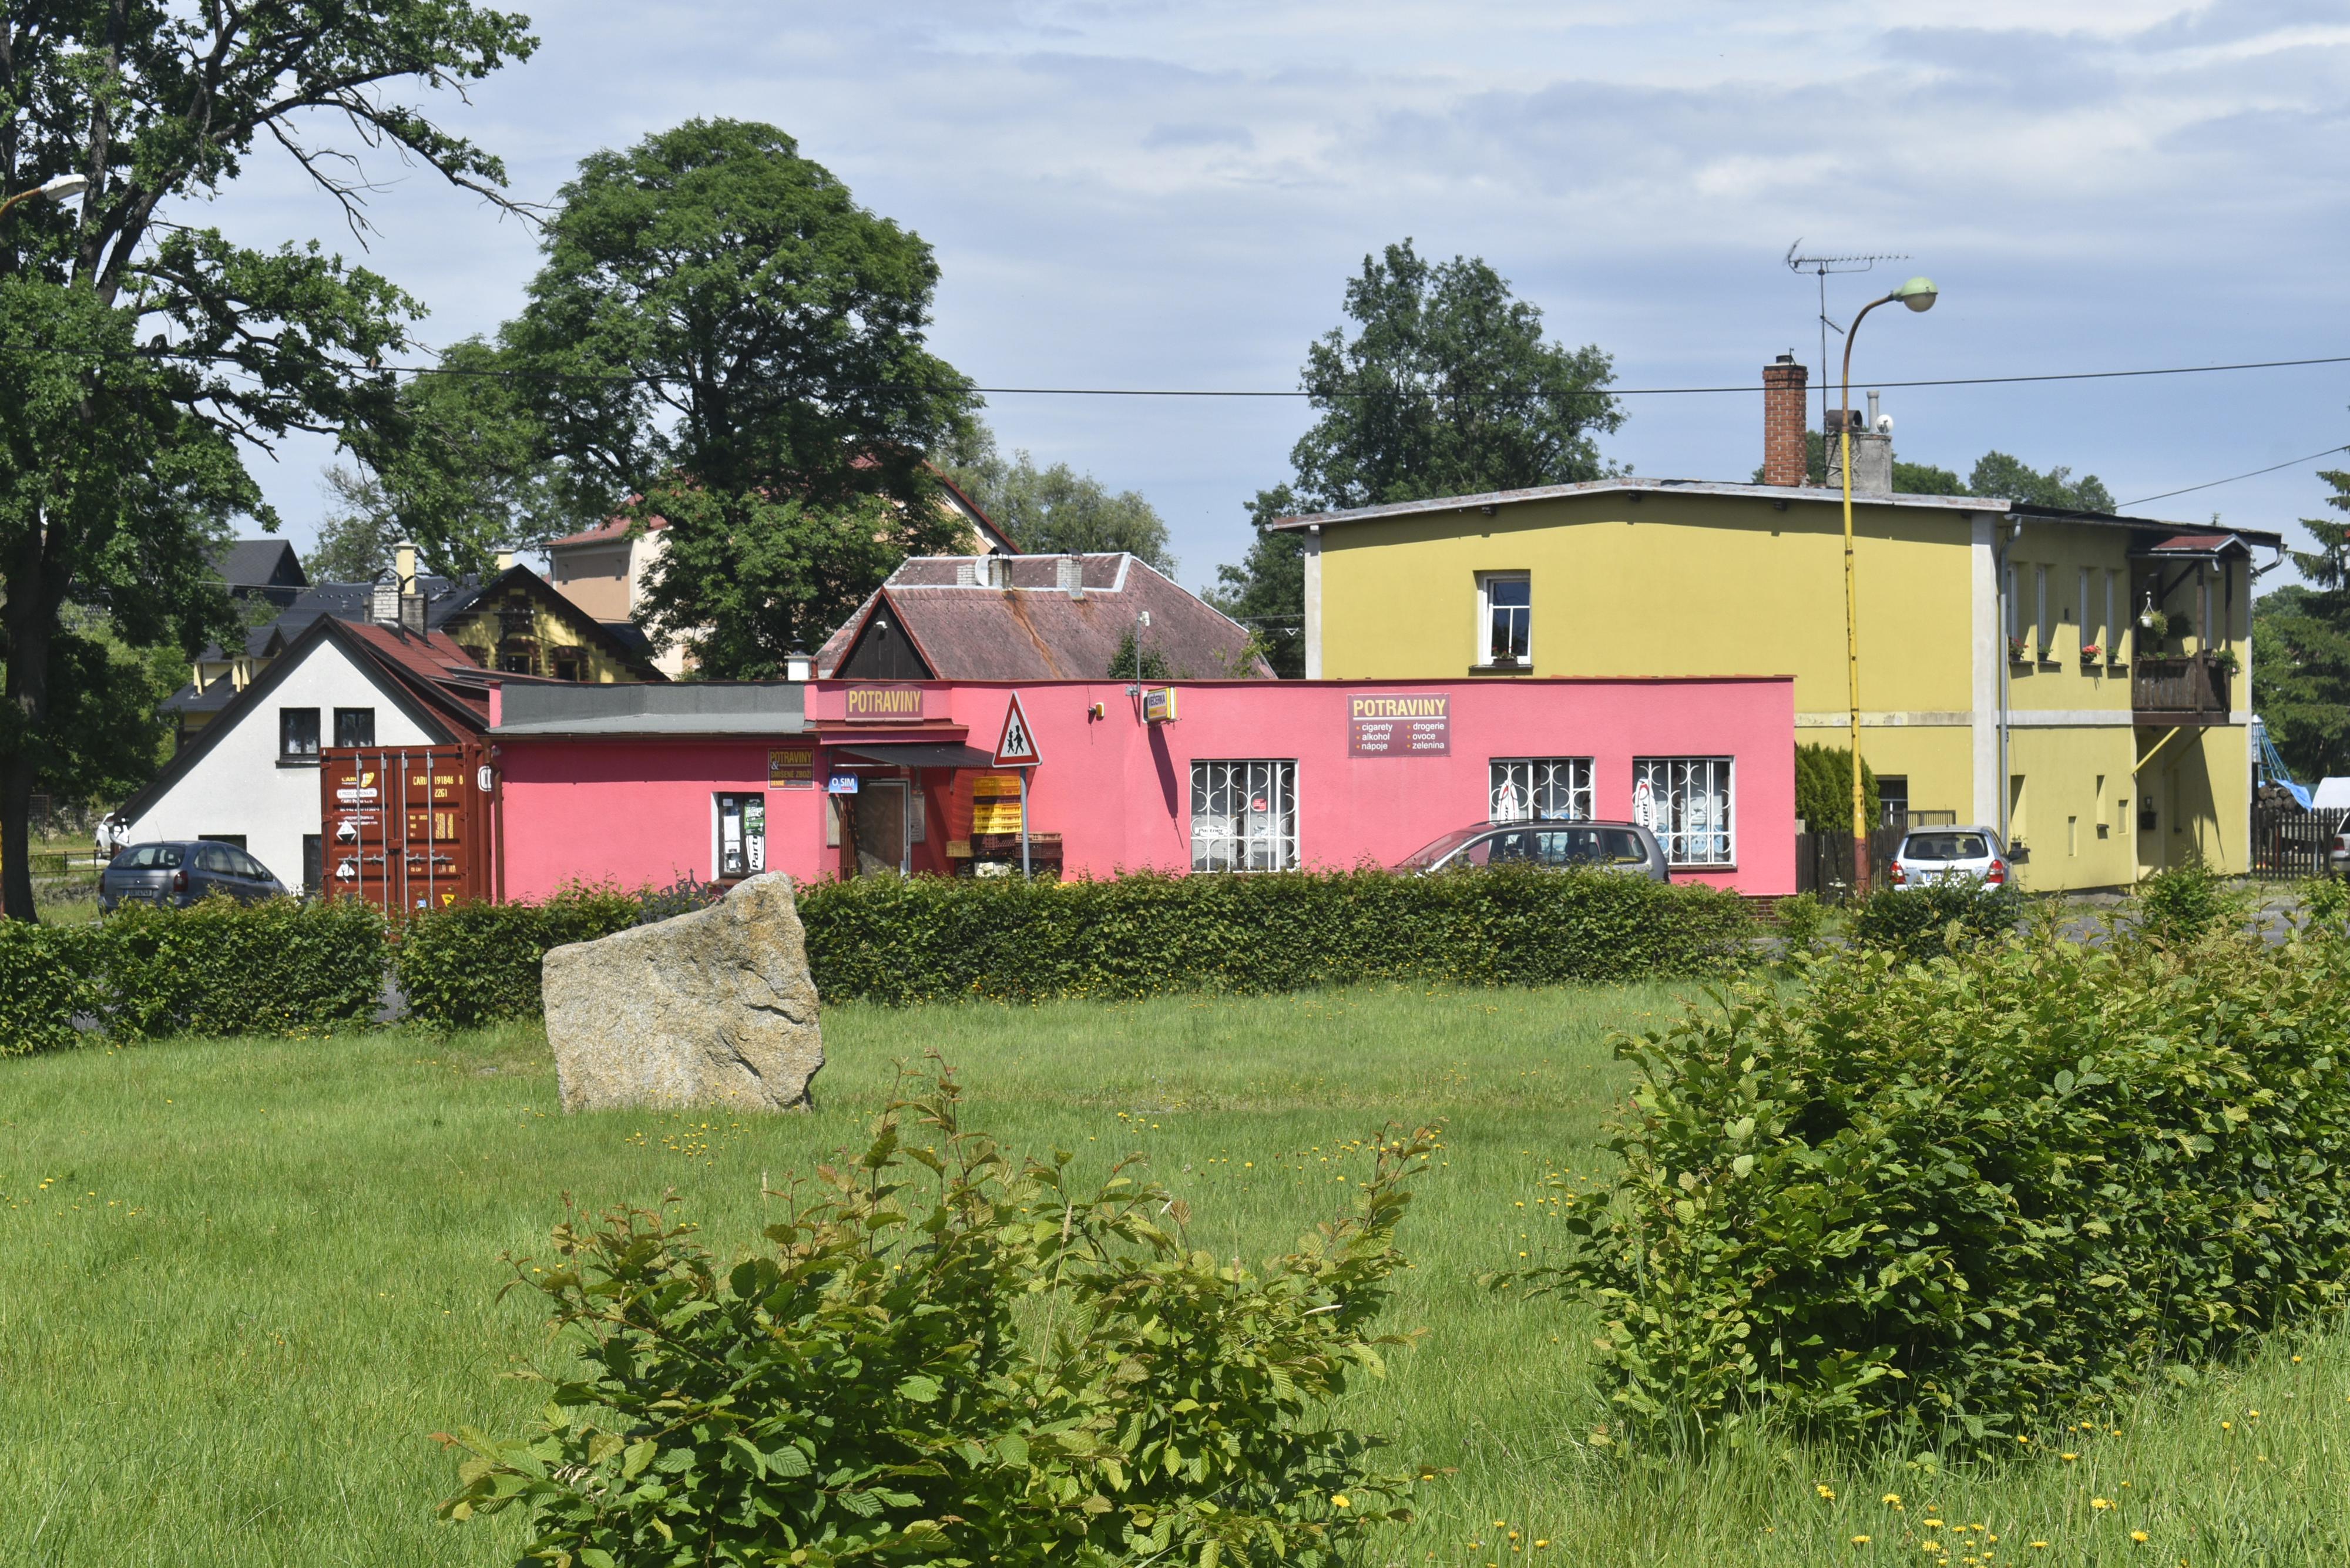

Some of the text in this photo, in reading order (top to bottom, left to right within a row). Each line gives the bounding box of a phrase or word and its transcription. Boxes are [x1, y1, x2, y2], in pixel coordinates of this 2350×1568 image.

[849, 690, 921, 713] POTRAVINY
[1353, 699, 1446, 716] POTRAVINY
[1362, 723, 1393, 732] cigarety
[1413, 722, 1445, 731] drogerie
[1362, 733, 1390, 741] alkohol
[1361, 742, 1388, 751] nápoje
[1412, 741, 1445, 749] zelenina
[770, 751, 812, 763] POTRAVINY
[771, 761, 778, 770] &
[413, 774, 464, 785] CARU 191846 8
[841, 778, 854, 786] SIM
[435, 788, 448, 797] 22G1
